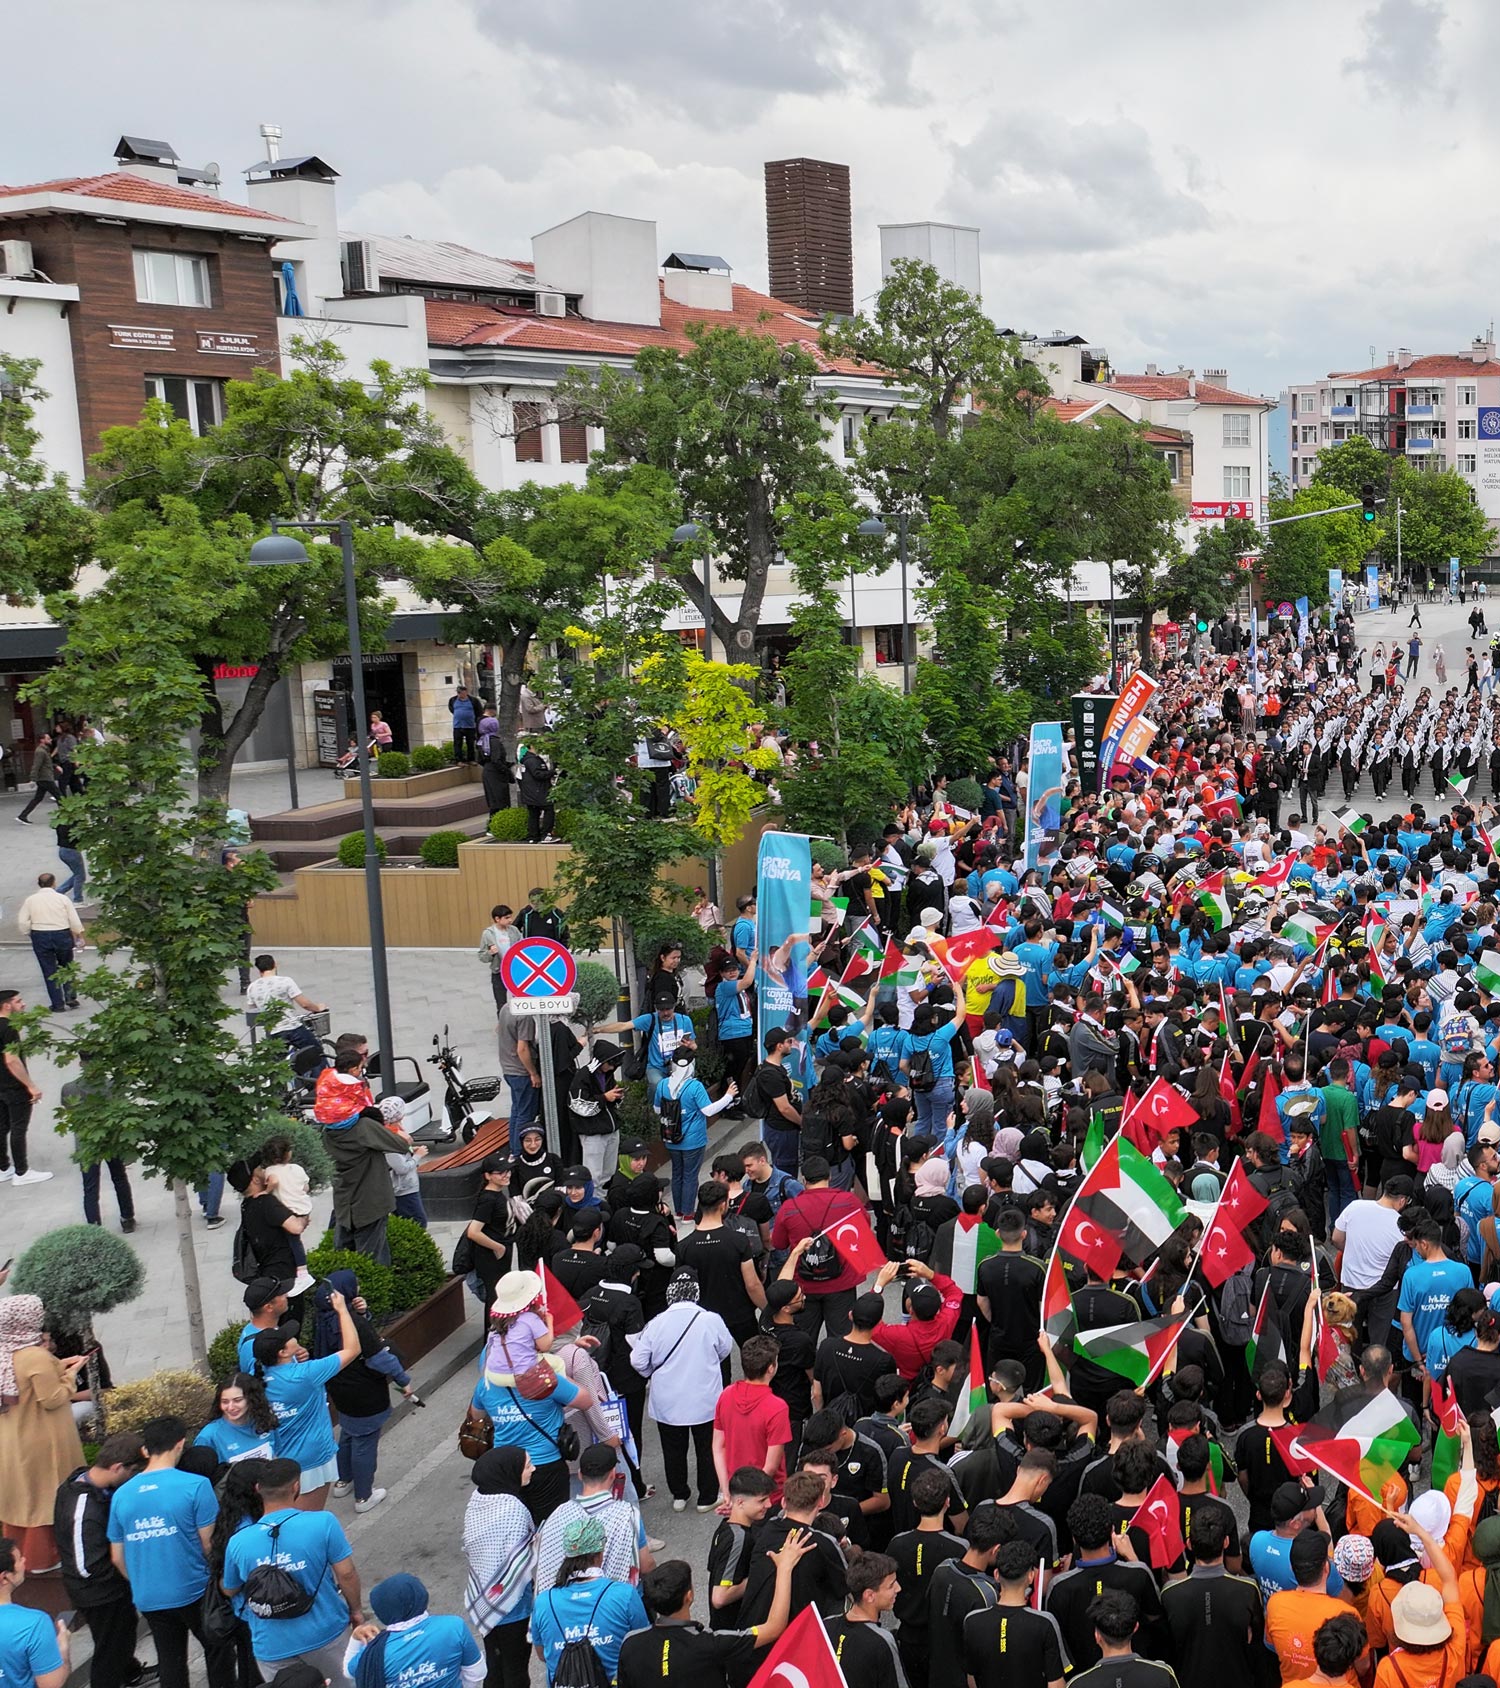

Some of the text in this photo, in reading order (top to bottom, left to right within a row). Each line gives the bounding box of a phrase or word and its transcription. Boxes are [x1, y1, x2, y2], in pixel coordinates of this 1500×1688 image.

[1108, 679, 1147, 741] FINISH
[1119, 723, 1148, 764] 2024
[514, 1000, 570, 1010] YOL BOYU
[135, 1516, 166, 1530] İYİLİĞE
[126, 1526, 178, 1543] KOŞUYORUZ
